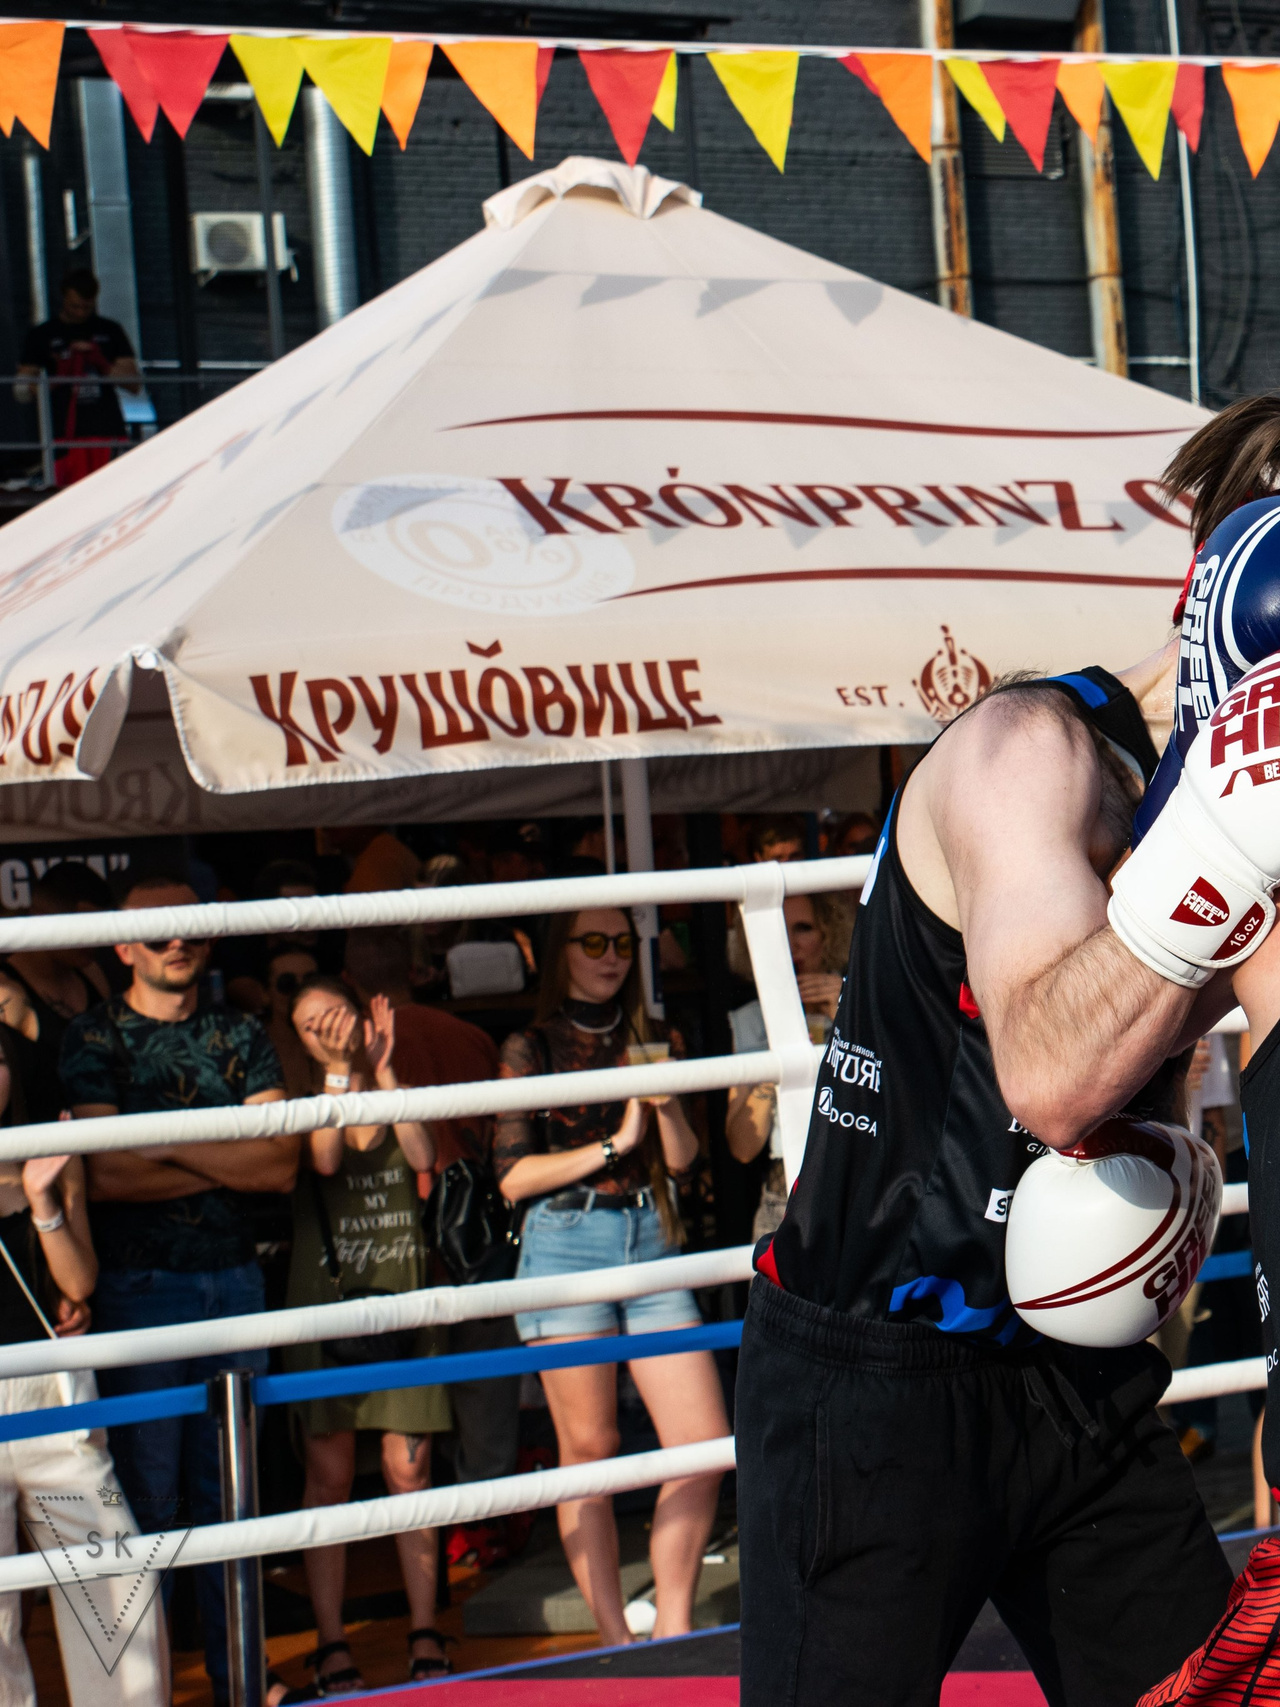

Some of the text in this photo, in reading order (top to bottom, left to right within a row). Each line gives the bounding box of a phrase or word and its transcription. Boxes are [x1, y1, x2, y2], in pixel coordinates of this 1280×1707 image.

[1190, 555, 1221, 720] GREE
[836, 685, 904, 707] EST.
[1263, 761, 1280, 780] BE
[1183, 897, 1215, 924] HILL
[1187, 890, 1228, 920] GREEN
[364, 1192, 388, 1210] MY
